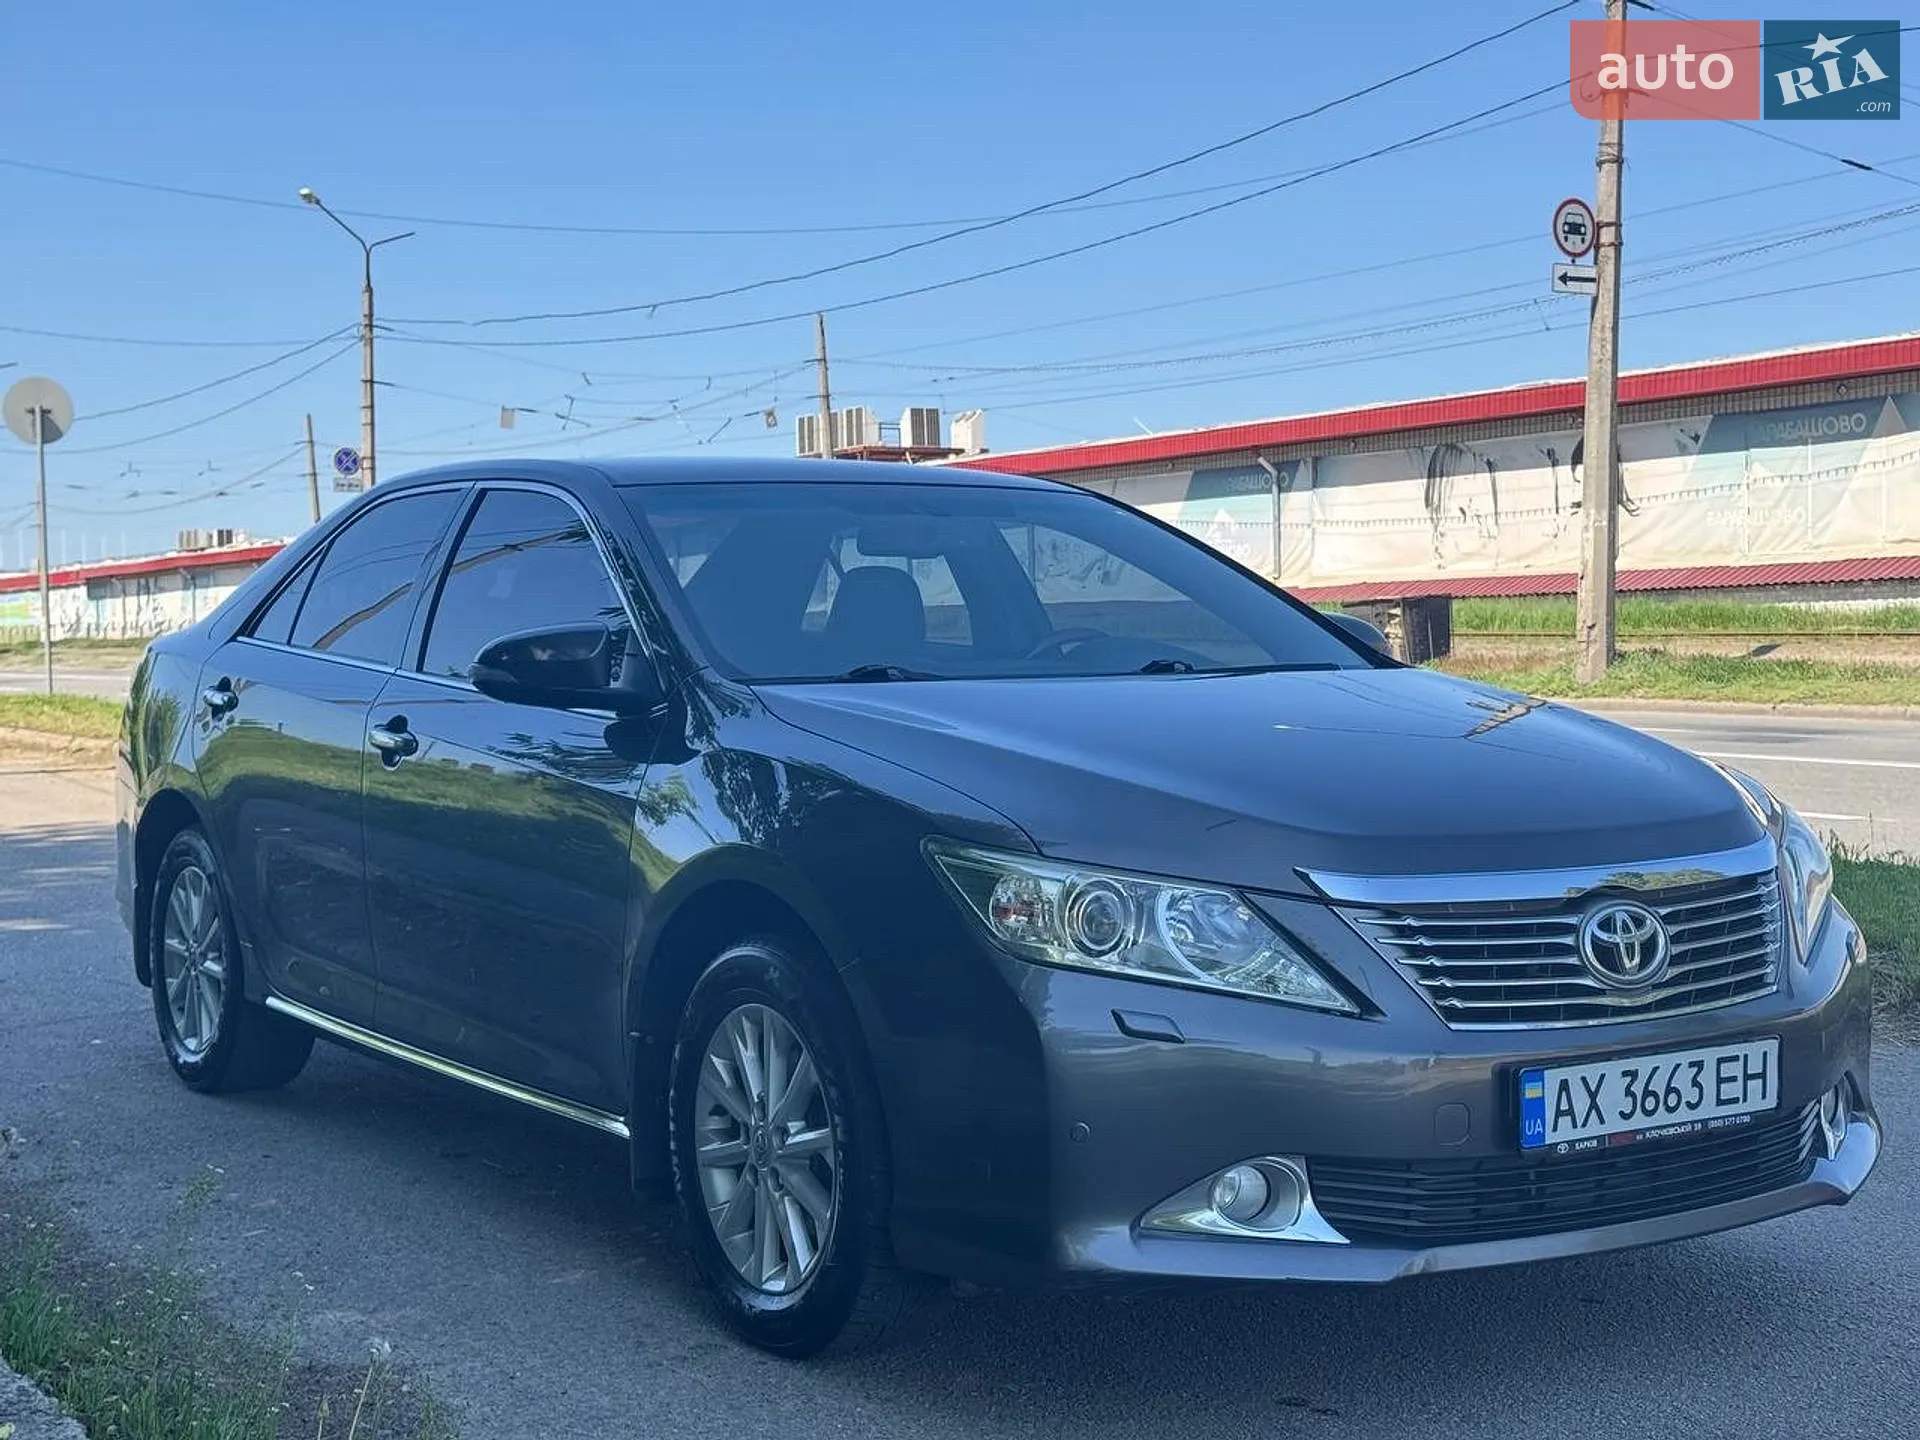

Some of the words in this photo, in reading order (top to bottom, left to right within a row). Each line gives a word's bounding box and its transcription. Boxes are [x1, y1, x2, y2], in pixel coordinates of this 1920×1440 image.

[1551, 1071, 1607, 1133] AX
[1618, 1059, 1705, 1121] 3663
[1714, 1050, 1768, 1107] EH
[1525, 1118, 1544, 1136] UA
